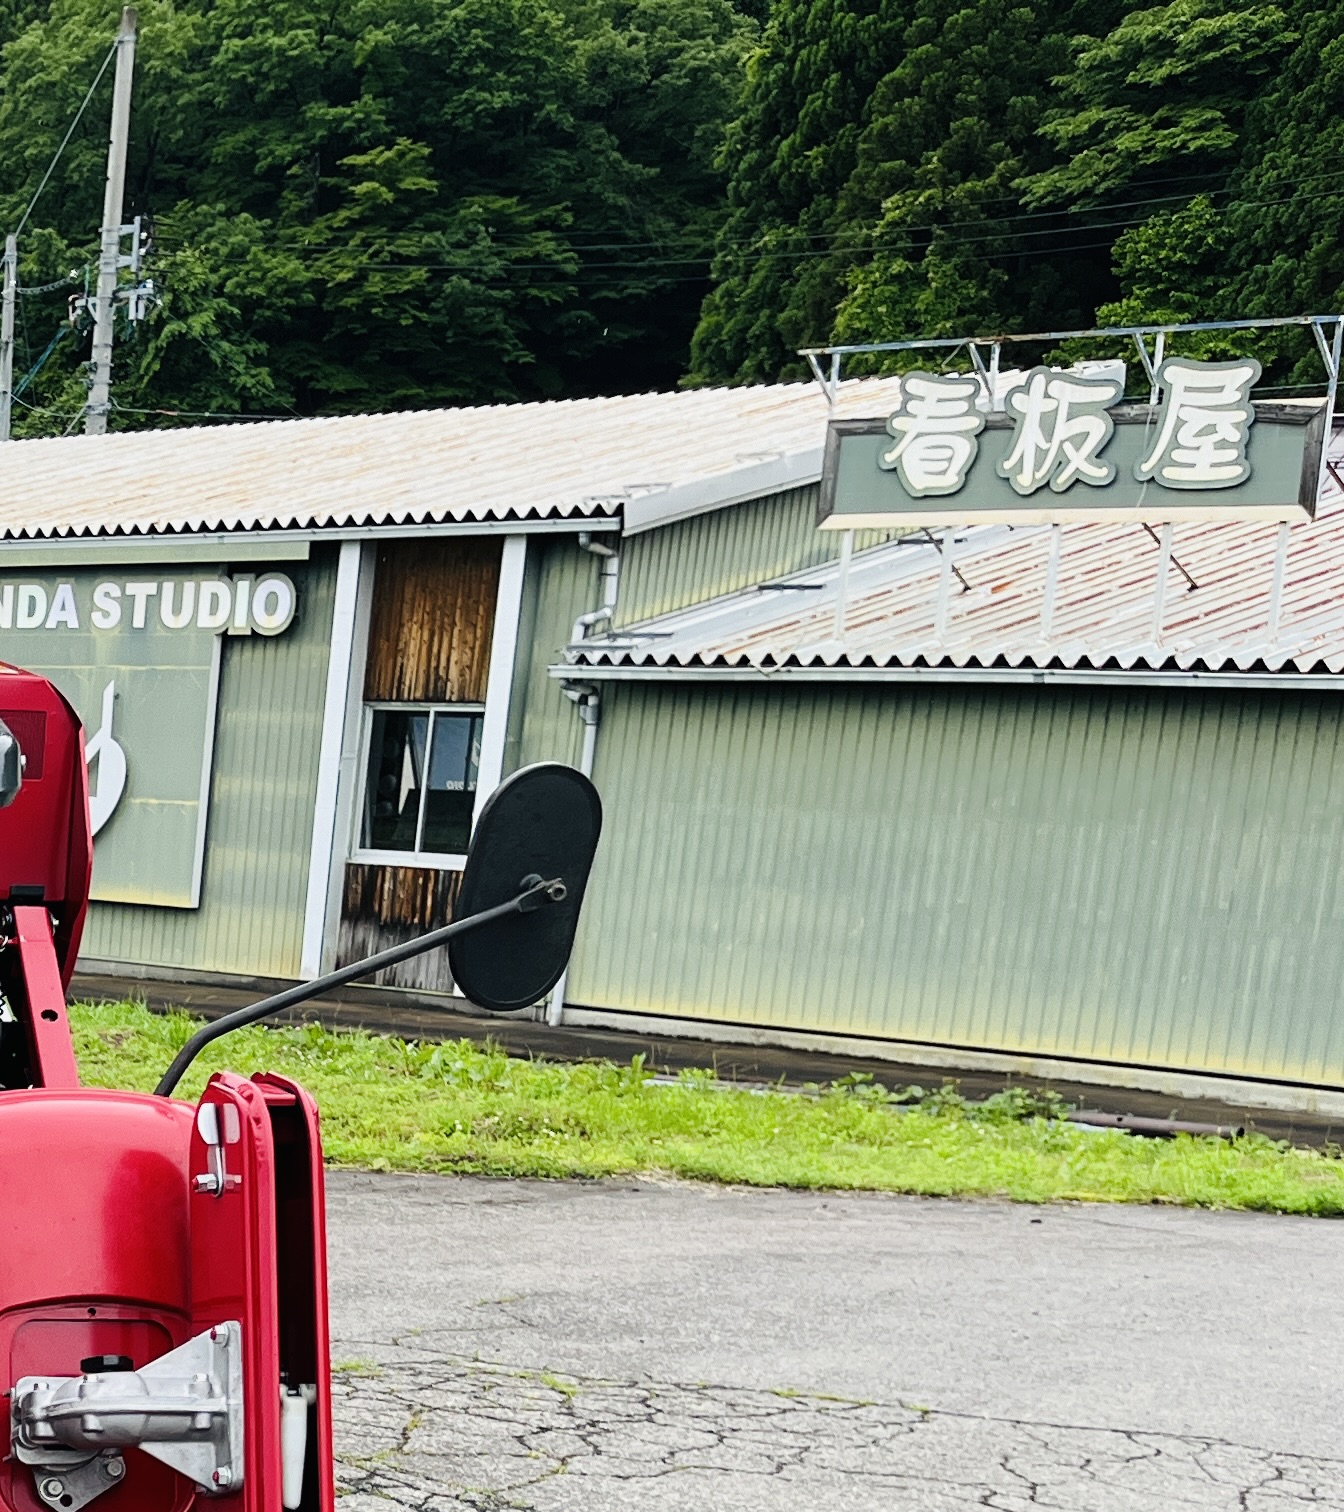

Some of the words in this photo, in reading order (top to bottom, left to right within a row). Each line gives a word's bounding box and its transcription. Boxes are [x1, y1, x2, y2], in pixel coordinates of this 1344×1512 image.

[882, 364, 1256, 491] 看板屋
[91, 578, 292, 630] STUDIO
